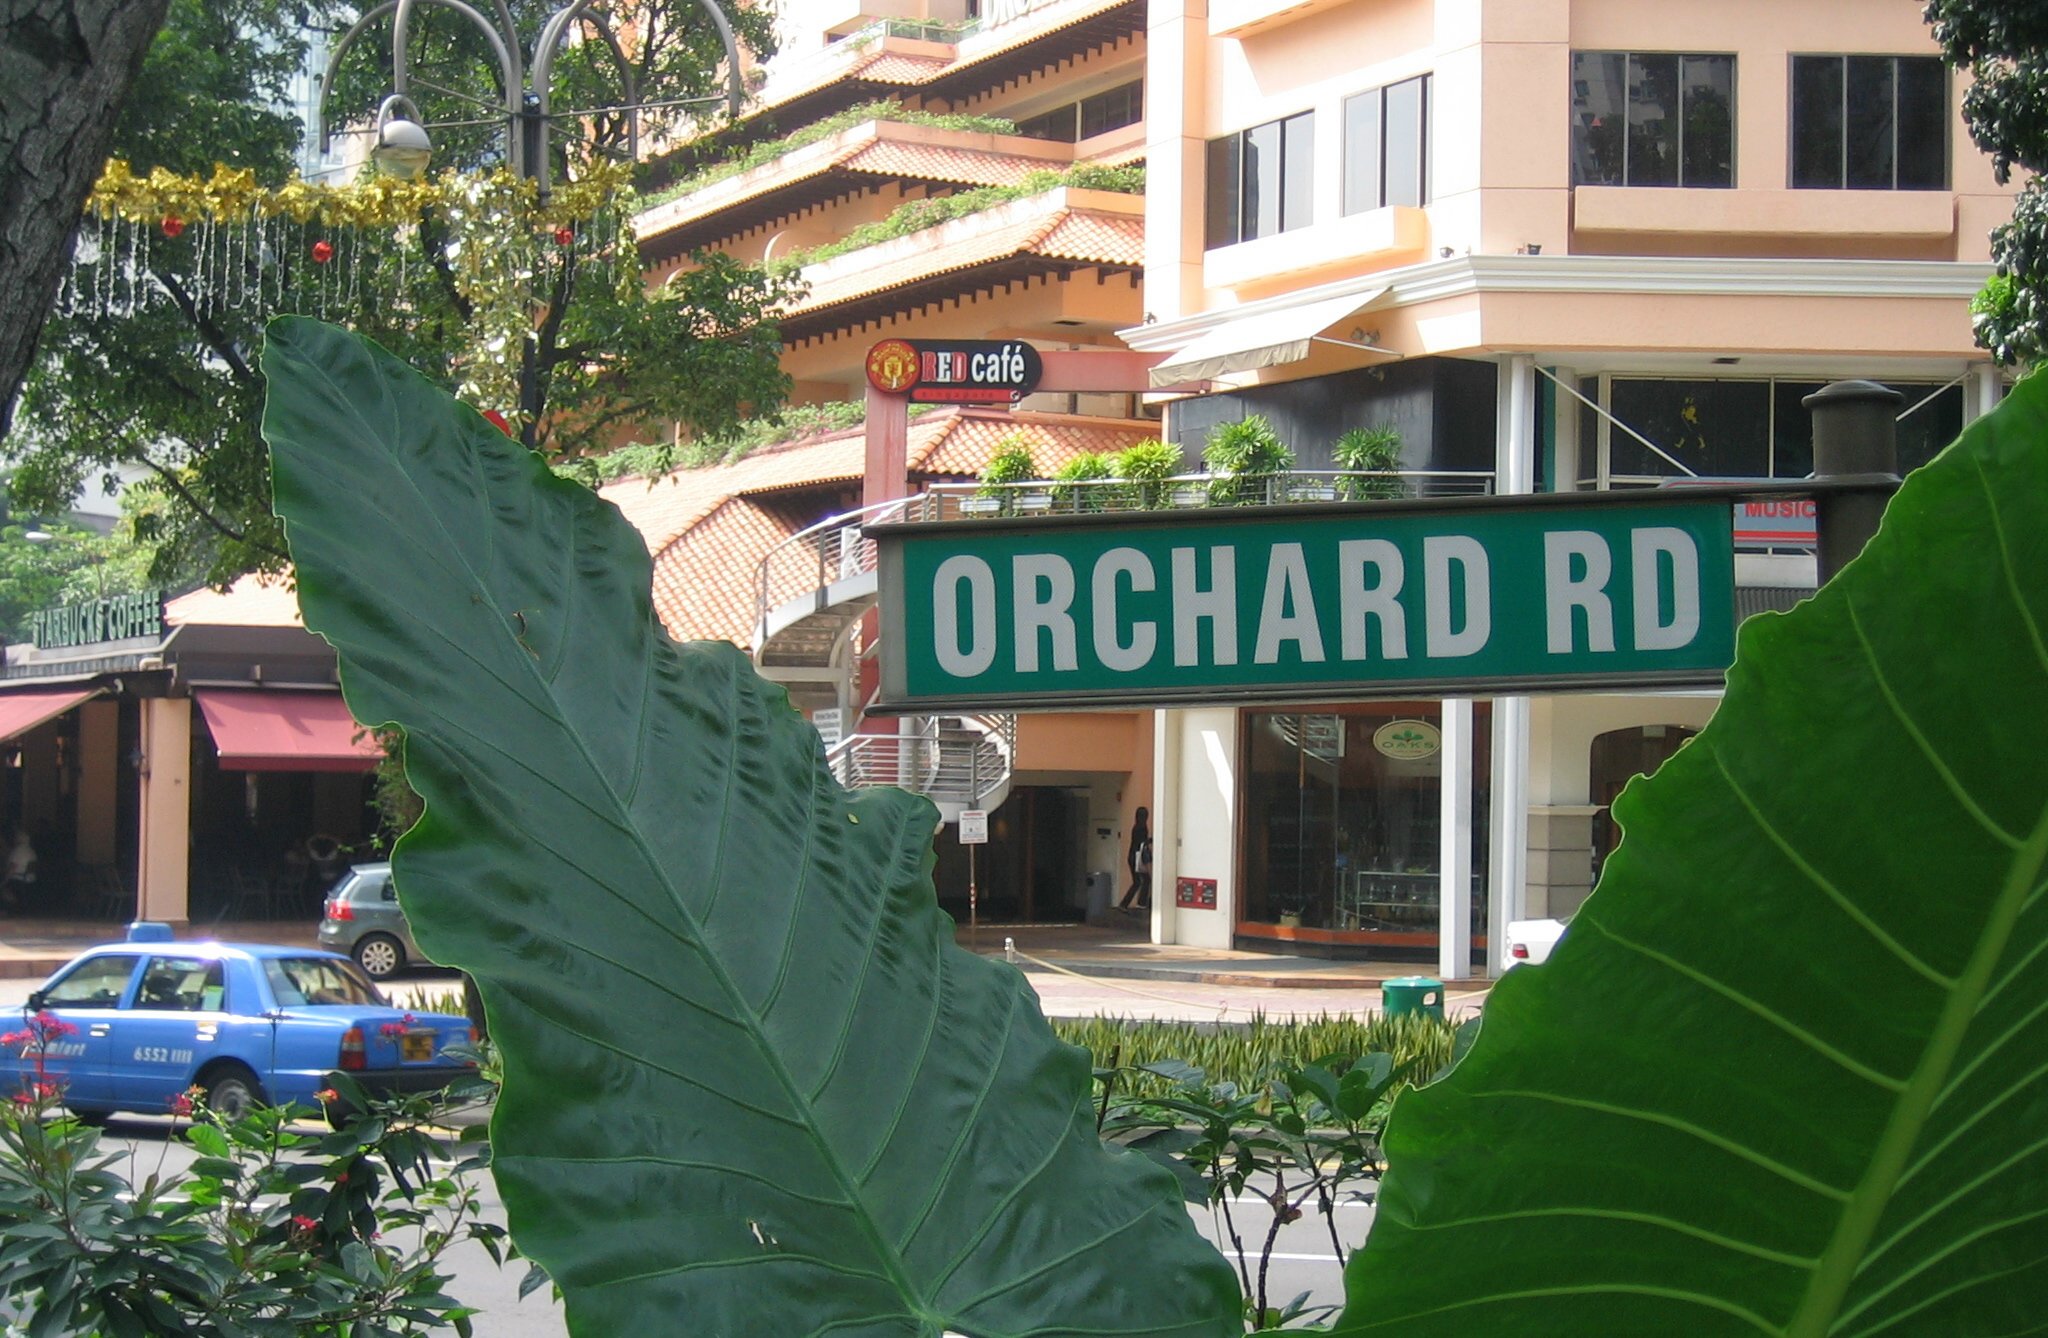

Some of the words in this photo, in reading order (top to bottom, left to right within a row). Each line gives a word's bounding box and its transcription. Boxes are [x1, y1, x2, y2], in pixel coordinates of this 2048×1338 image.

[921, 351, 968, 382] RED
[971, 345, 1025, 383] café
[1745, 501, 1816, 518] MUSIC
[933, 536, 1491, 678] ORCHARD
[1545, 528, 1700, 653] RD
[33, 599, 104, 649] STARBUCKS
[107, 590, 160, 641] COFFEE
[1382, 741, 1434, 749] OAKS
[134, 1047, 167, 1062] 6552
